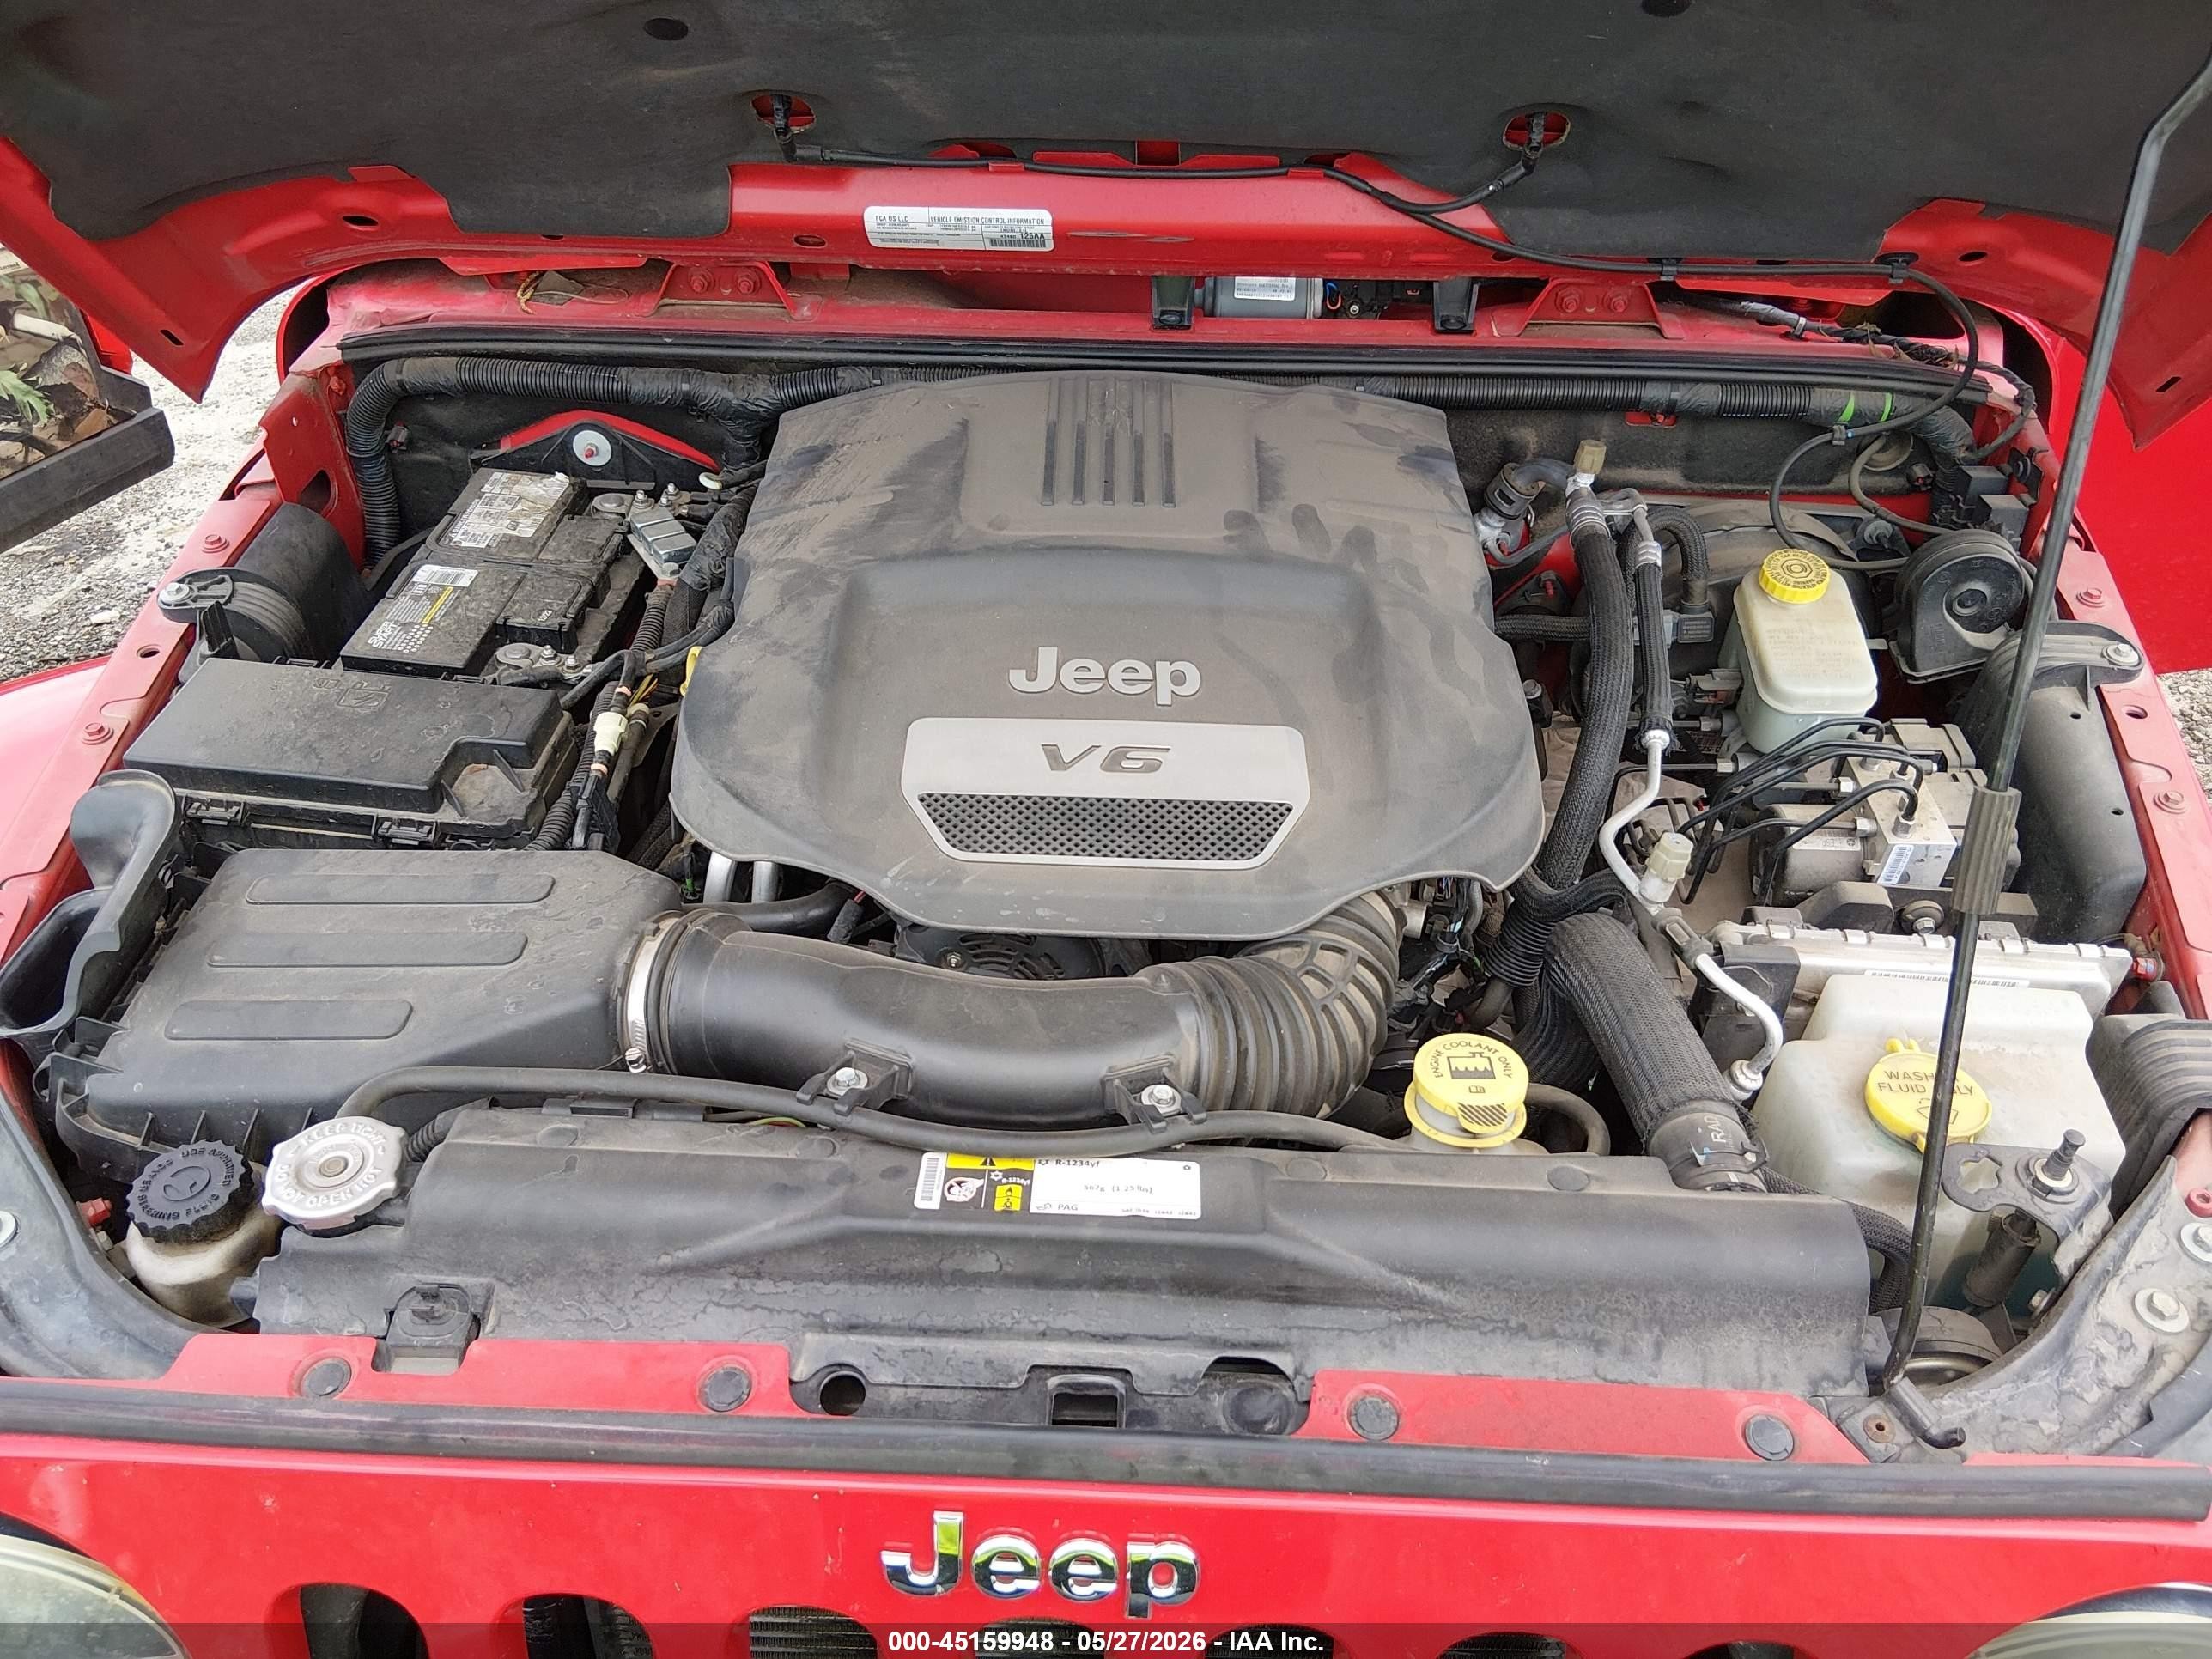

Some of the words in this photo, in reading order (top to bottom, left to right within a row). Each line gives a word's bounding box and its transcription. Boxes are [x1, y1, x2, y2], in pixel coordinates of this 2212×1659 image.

[1008, 645, 1201, 707] Jeep
[1041, 744, 1172, 774] V6
[1429, 1049, 1444, 1079] ENGINE
[1443, 1040, 1499, 1055] COOLANT
[1498, 1056, 1512, 1079] ONLY
[1877, 1082, 1927, 1093] FLUID
[1883, 1070, 1959, 1082] WASH
[300, 1122, 345, 1146] KEEP
[1704, 1115, 1727, 1144] RAD
[181, 1146, 207, 1158] USE
[208, 1148, 235, 1187] APPROVED
[1054, 1158, 1101, 1169] R-1234yf
[306, 1188, 354, 1206] OPEN
[354, 1165, 384, 1193] HOT
[1057, 1203, 1079, 1212] PAG
[879, 1510, 1201, 1619] Jeep
